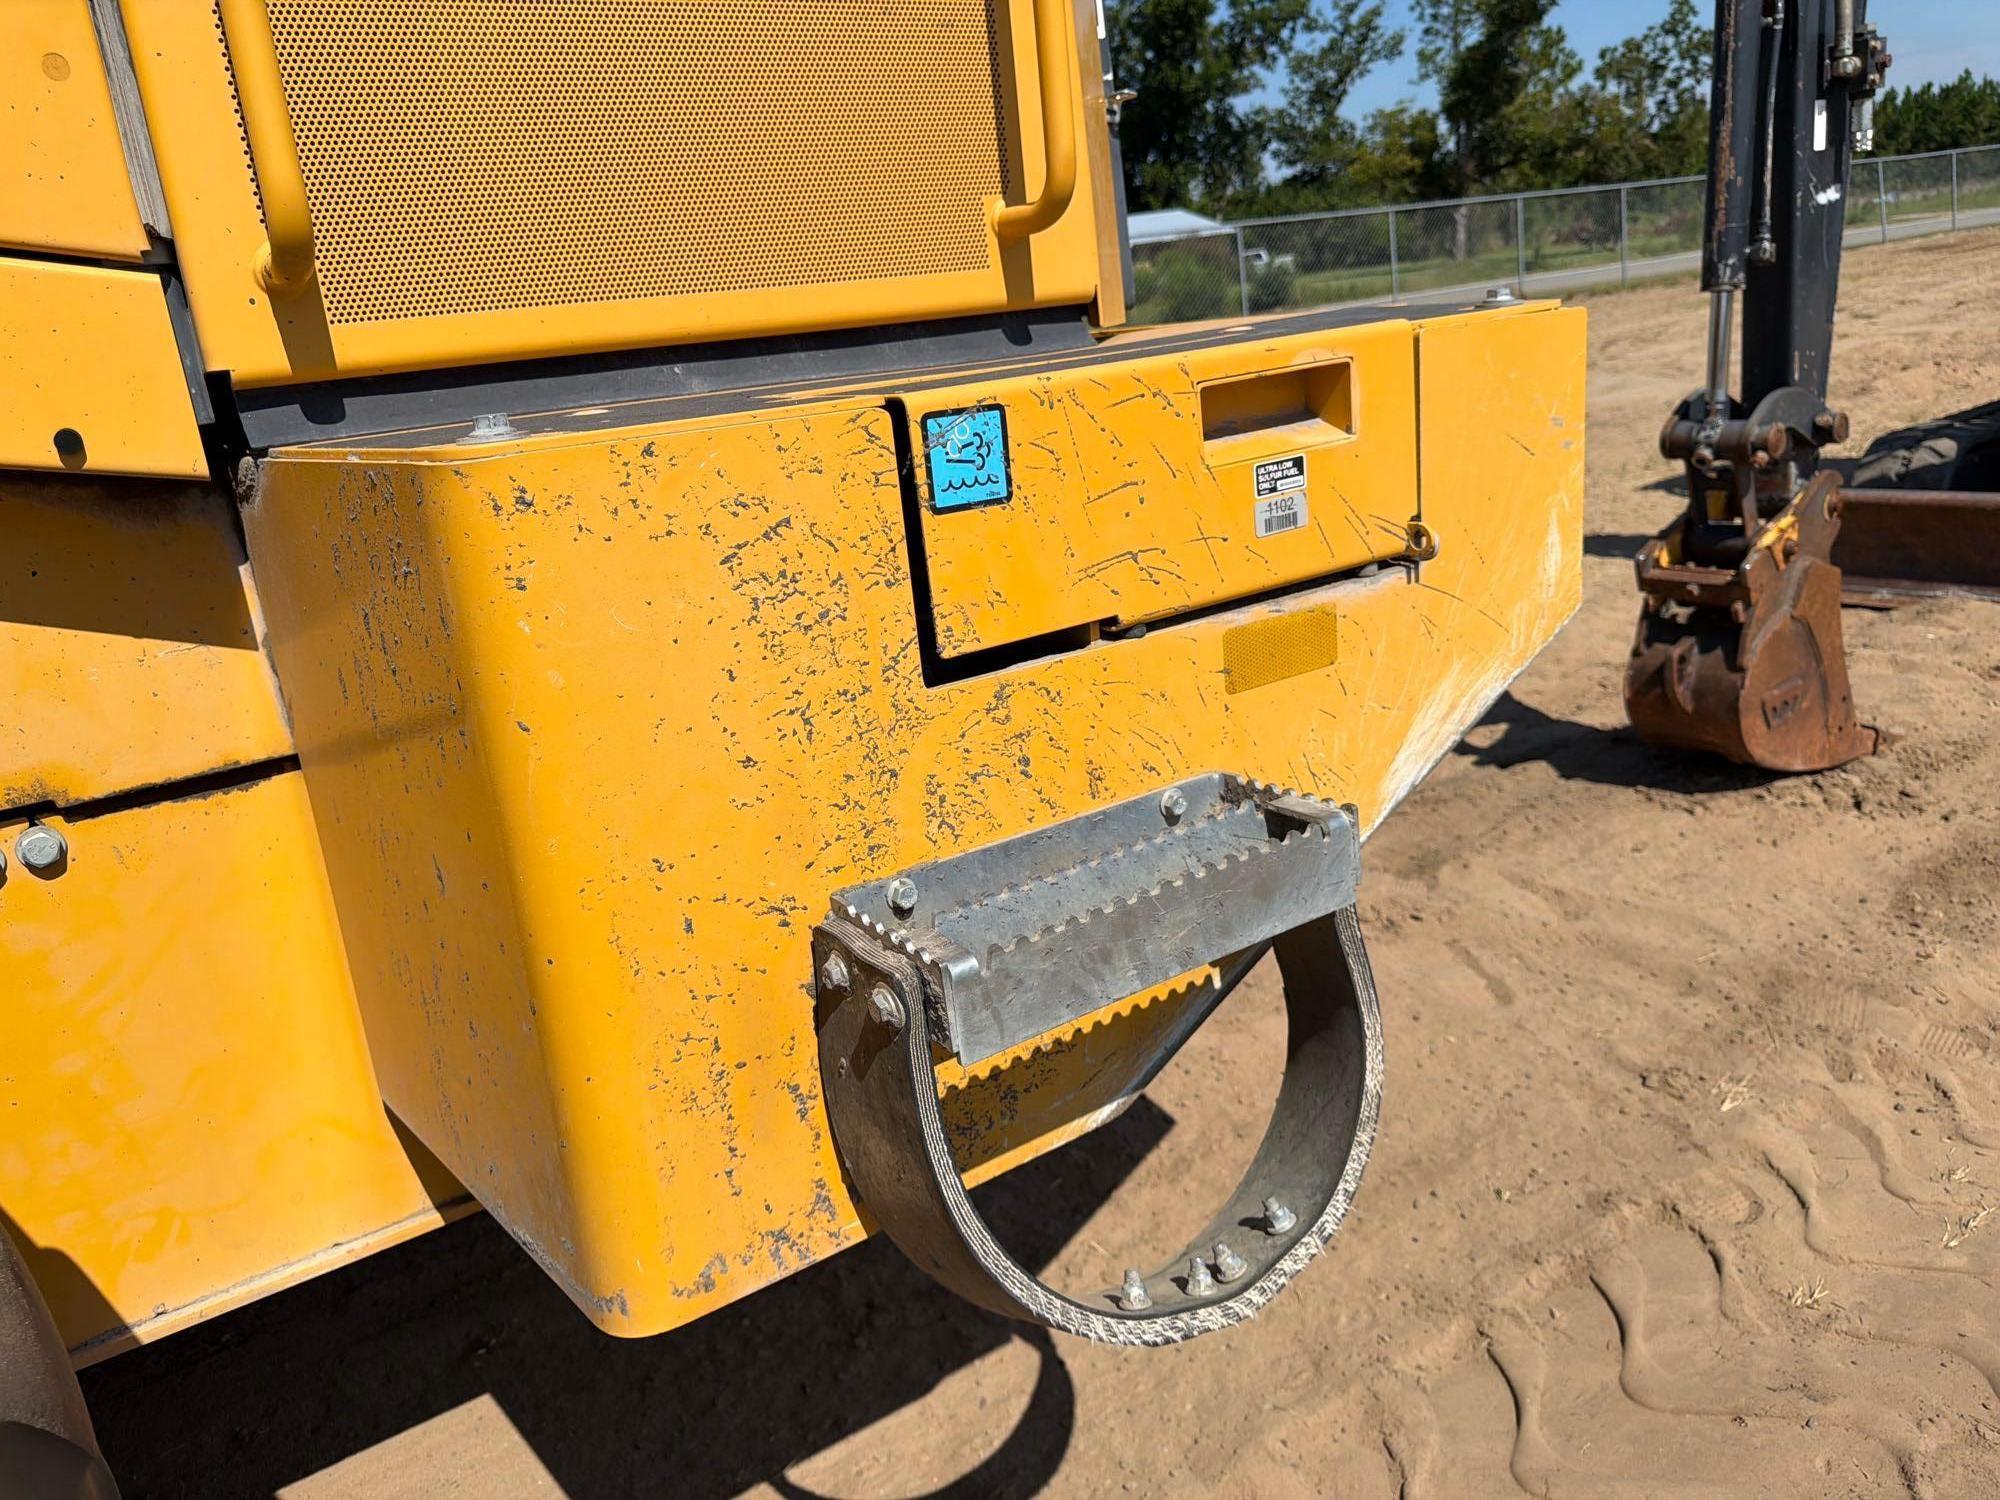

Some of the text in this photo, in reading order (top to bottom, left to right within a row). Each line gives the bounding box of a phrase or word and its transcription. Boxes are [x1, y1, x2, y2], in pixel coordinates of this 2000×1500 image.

[1258, 461, 1293, 474] ULTRA LOW
[1283, 467, 1299, 477] FUEL
[1259, 480, 1275, 490] ONLY
